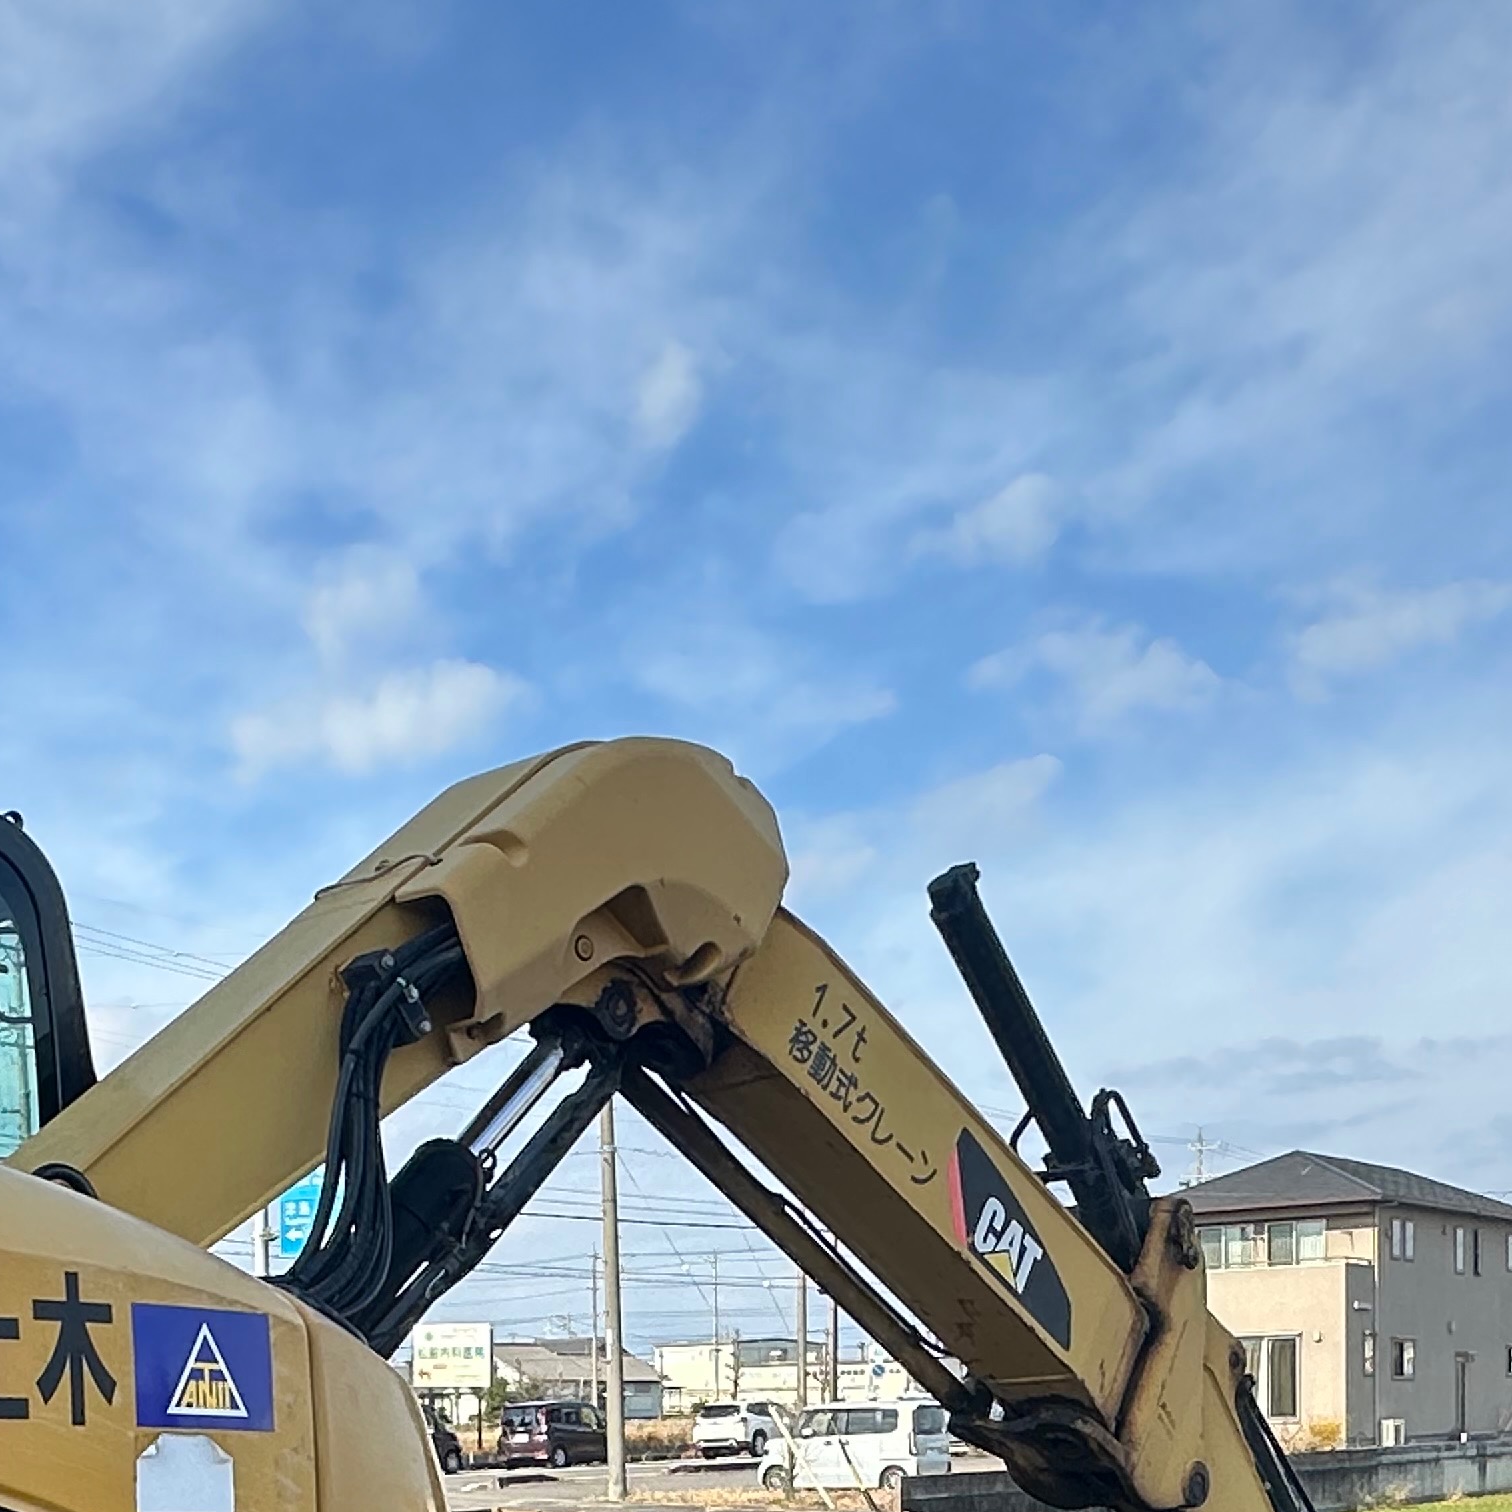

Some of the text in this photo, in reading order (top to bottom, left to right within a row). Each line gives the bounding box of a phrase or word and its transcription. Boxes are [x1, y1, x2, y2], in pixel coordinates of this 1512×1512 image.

[812, 983, 868, 1063] 1.7t
[788, 1018, 938, 1185] 移動式クレーン
[974, 1196, 1044, 1295] CAT
